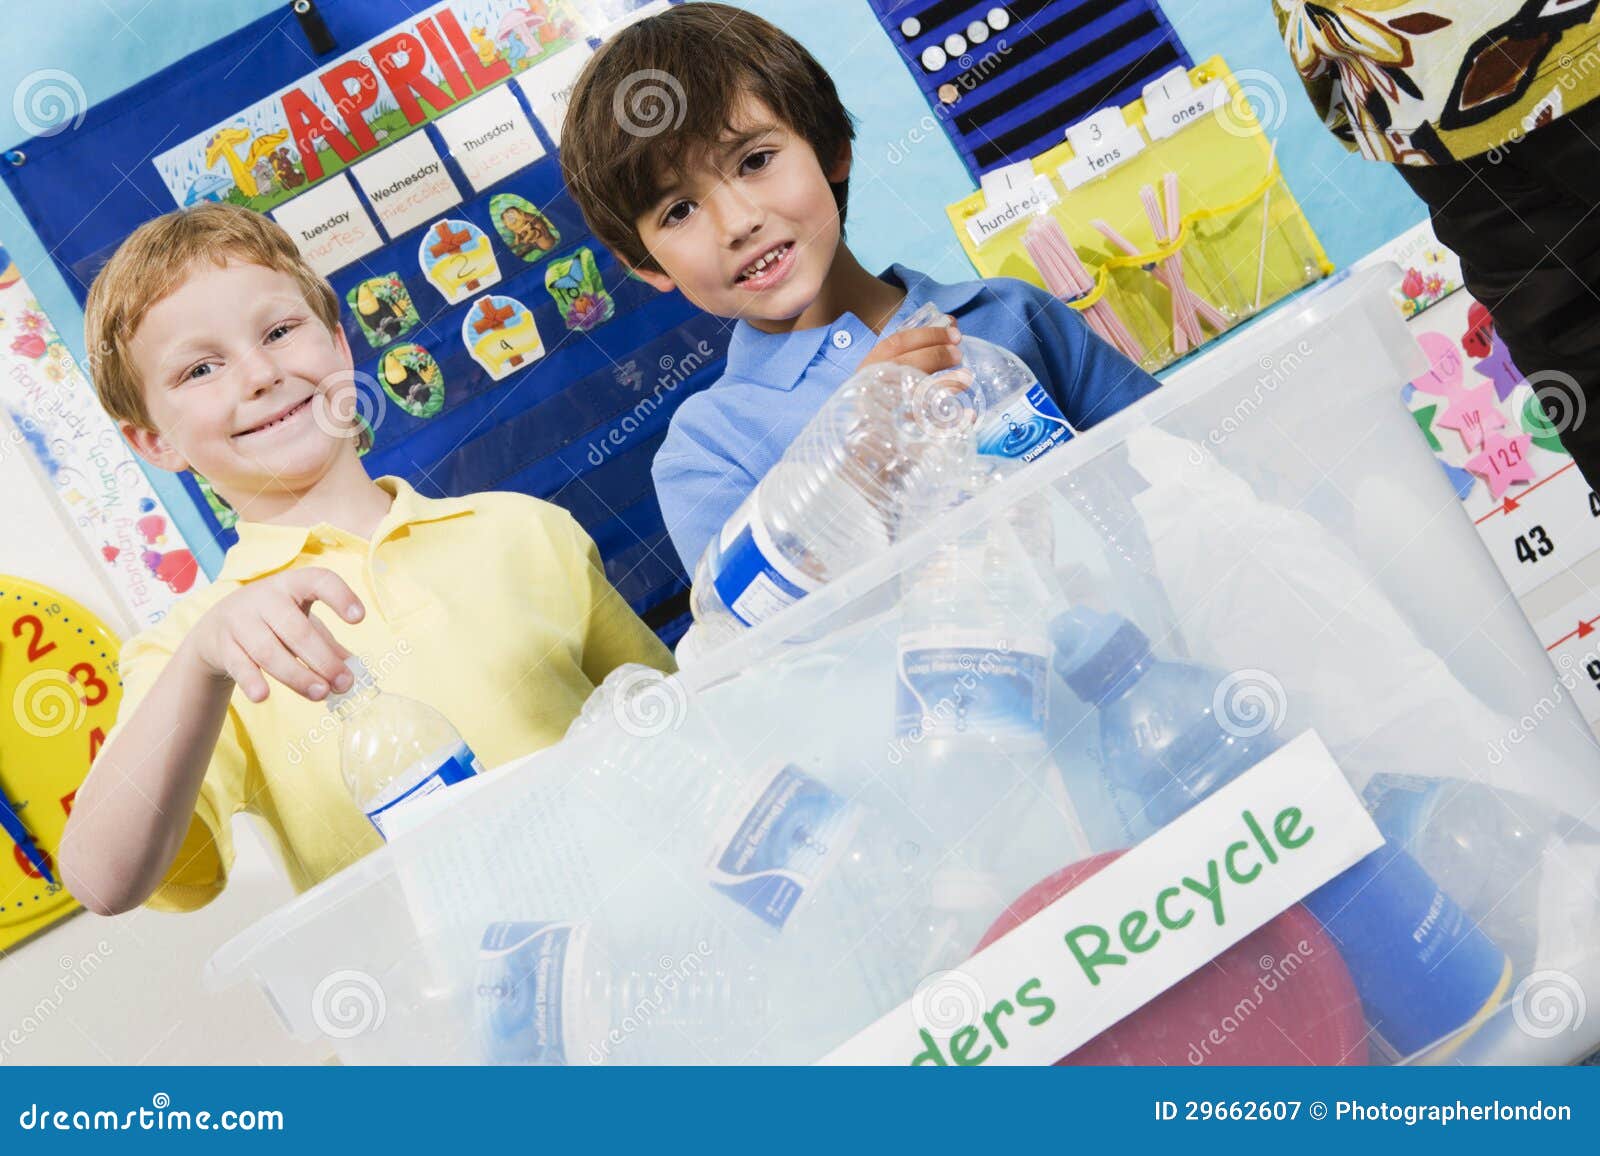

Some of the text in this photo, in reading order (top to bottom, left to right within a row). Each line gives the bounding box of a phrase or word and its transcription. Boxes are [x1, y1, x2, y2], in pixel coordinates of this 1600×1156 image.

[280, 9, 511, 184] APRIL
[1171, 101, 1205, 124] ones
[463, 120, 515, 152] Thursday
[1089, 123, 1103, 142] 3
[1087, 148, 1121, 171] tens
[370, 161, 440, 202] Wednesday
[301, 211, 350, 241] Tuesday
[976, 186, 1049, 235] hundreds
[450, 254, 477, 279] 2
[10, 363, 48, 401] May
[1024, 438, 1054, 463] Drinking
[1488, 440, 1522, 475] 129
[86, 445, 122, 508] March
[113, 517, 152, 608] February
[1514, 525, 1555, 563] 43
[45, 603, 61, 616] 10
[12, 614, 57, 663] 2
[67, 662, 108, 707] 3
[1064, 806, 1316, 986] Recycle
